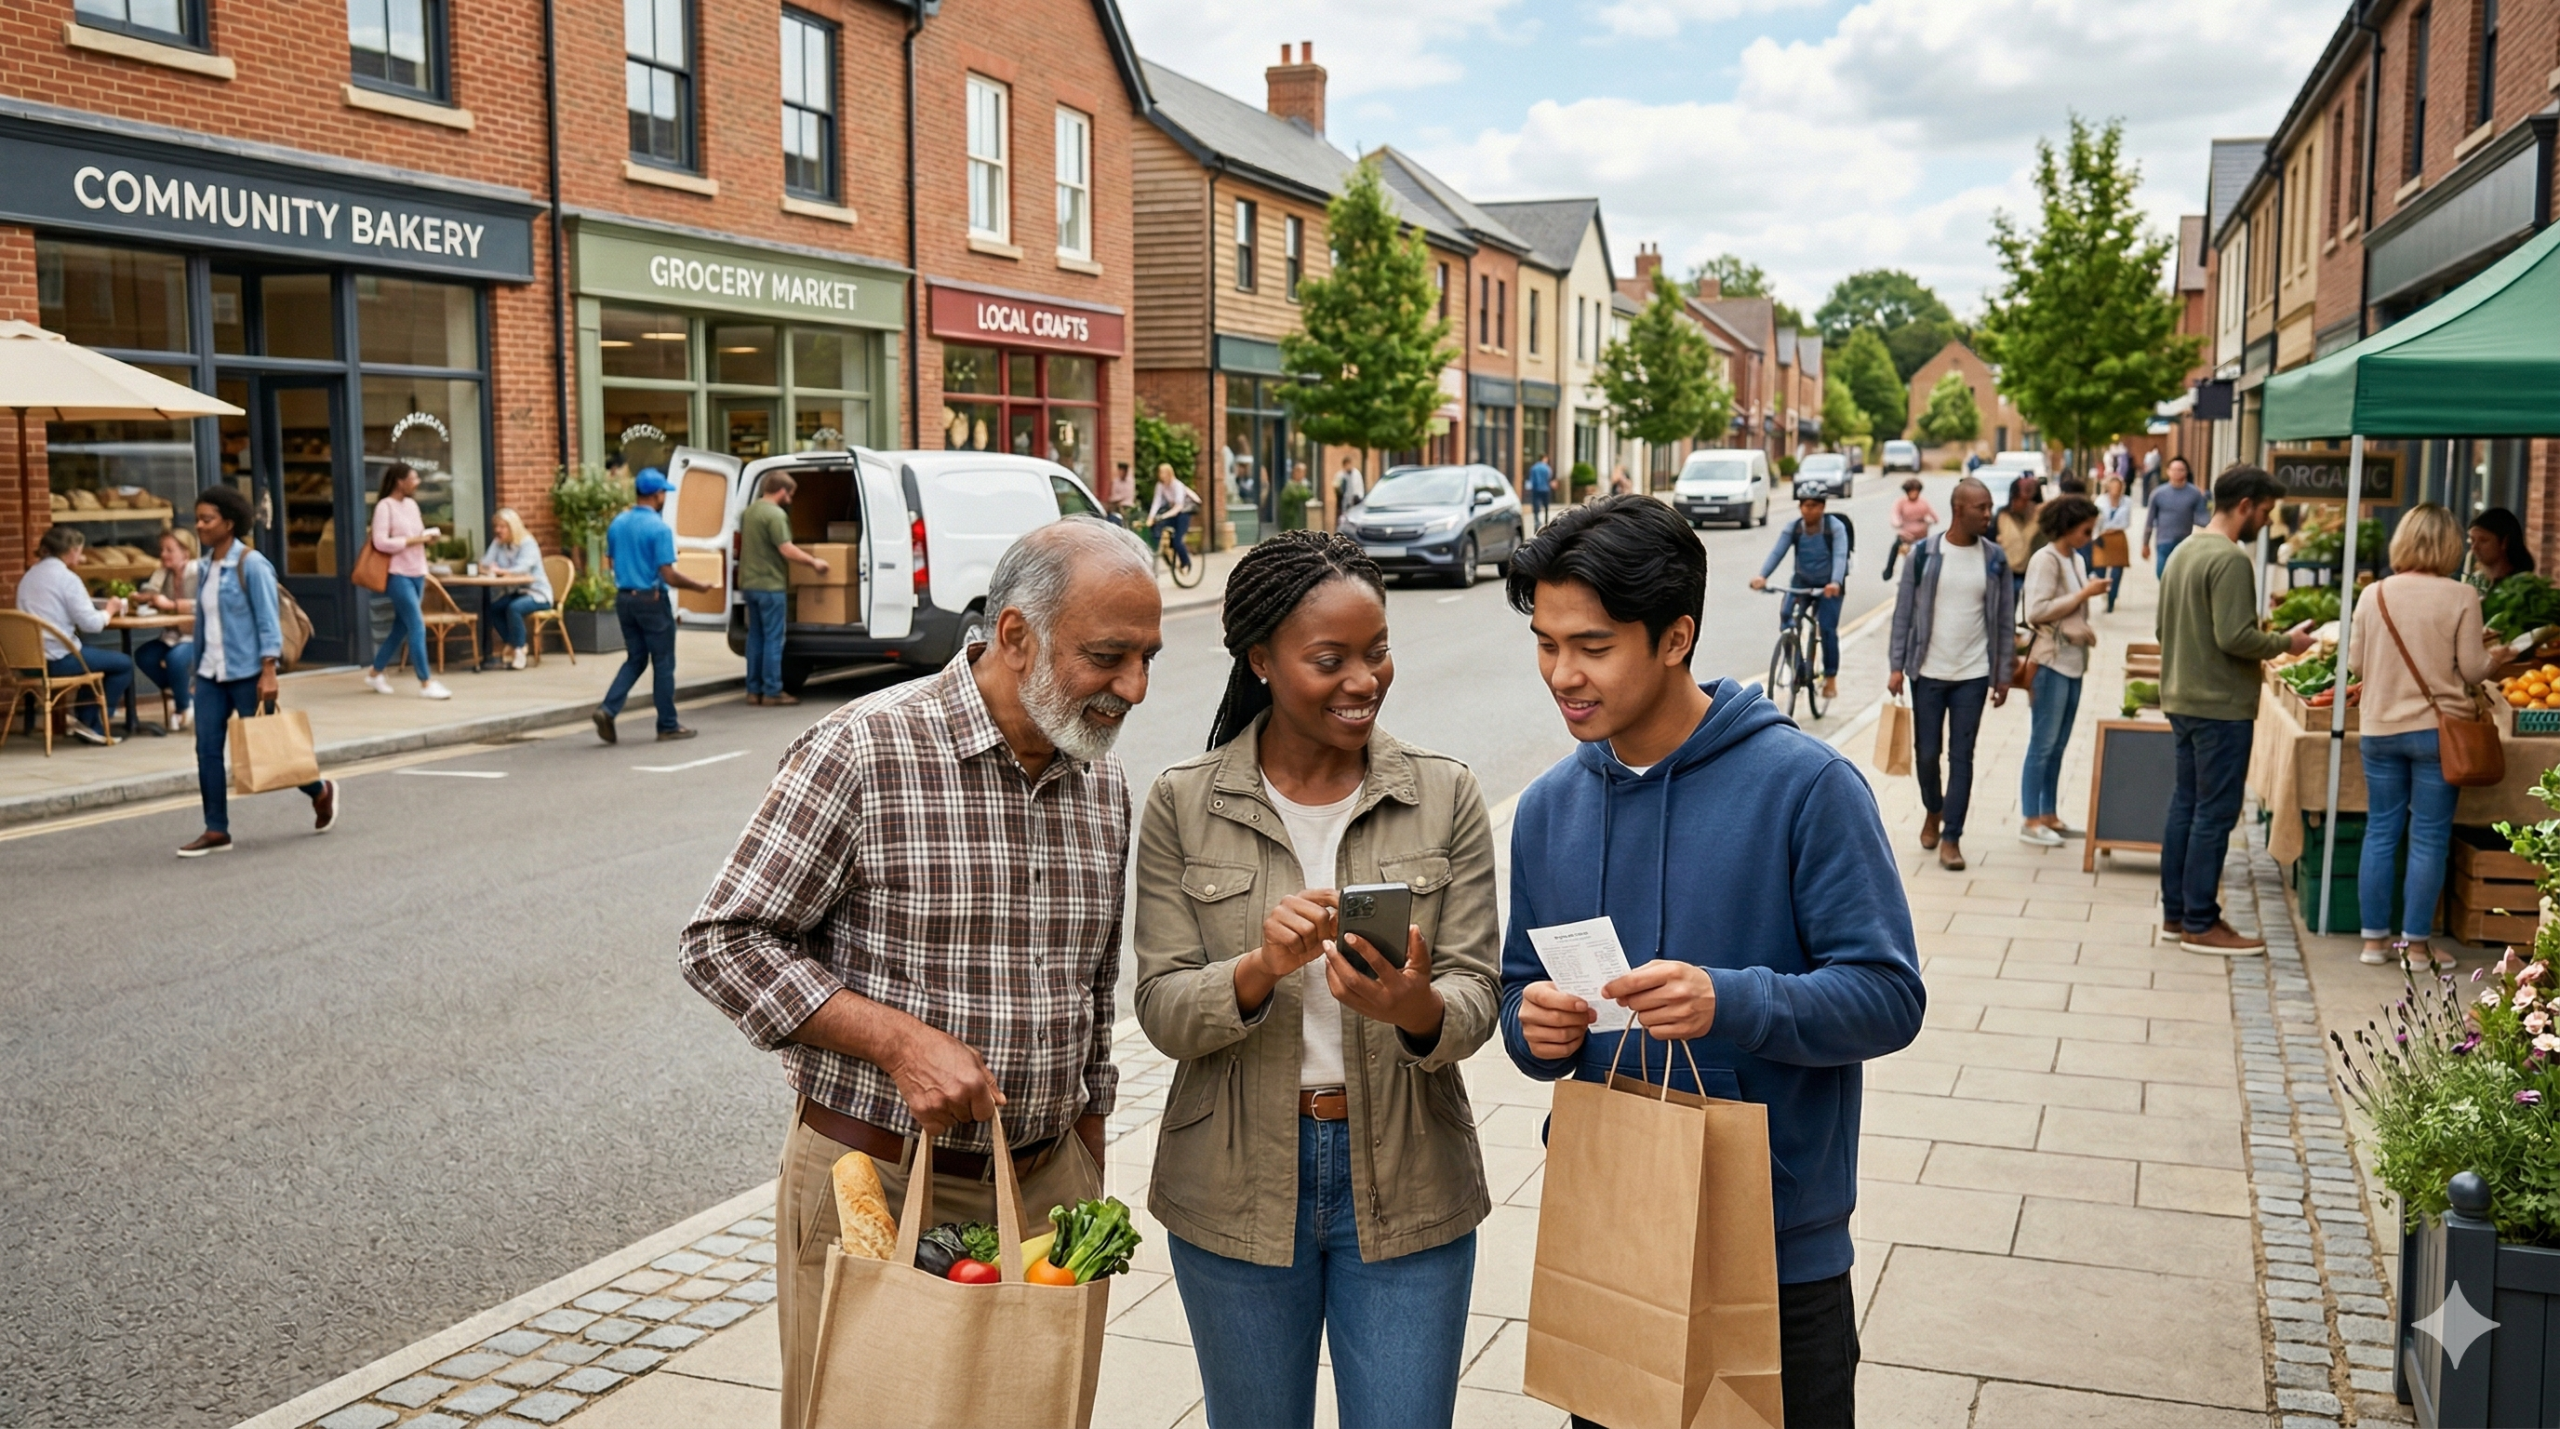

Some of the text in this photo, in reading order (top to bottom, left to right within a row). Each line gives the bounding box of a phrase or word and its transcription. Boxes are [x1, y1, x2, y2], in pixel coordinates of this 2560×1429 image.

[73, 165, 486, 259] COMMUNITY BAKERY
[649, 254, 858, 312] GROCERY MARKET
[977, 301, 1089, 343] LOCAL CRAFTS
[2278, 463, 2389, 491] ORGAIC
